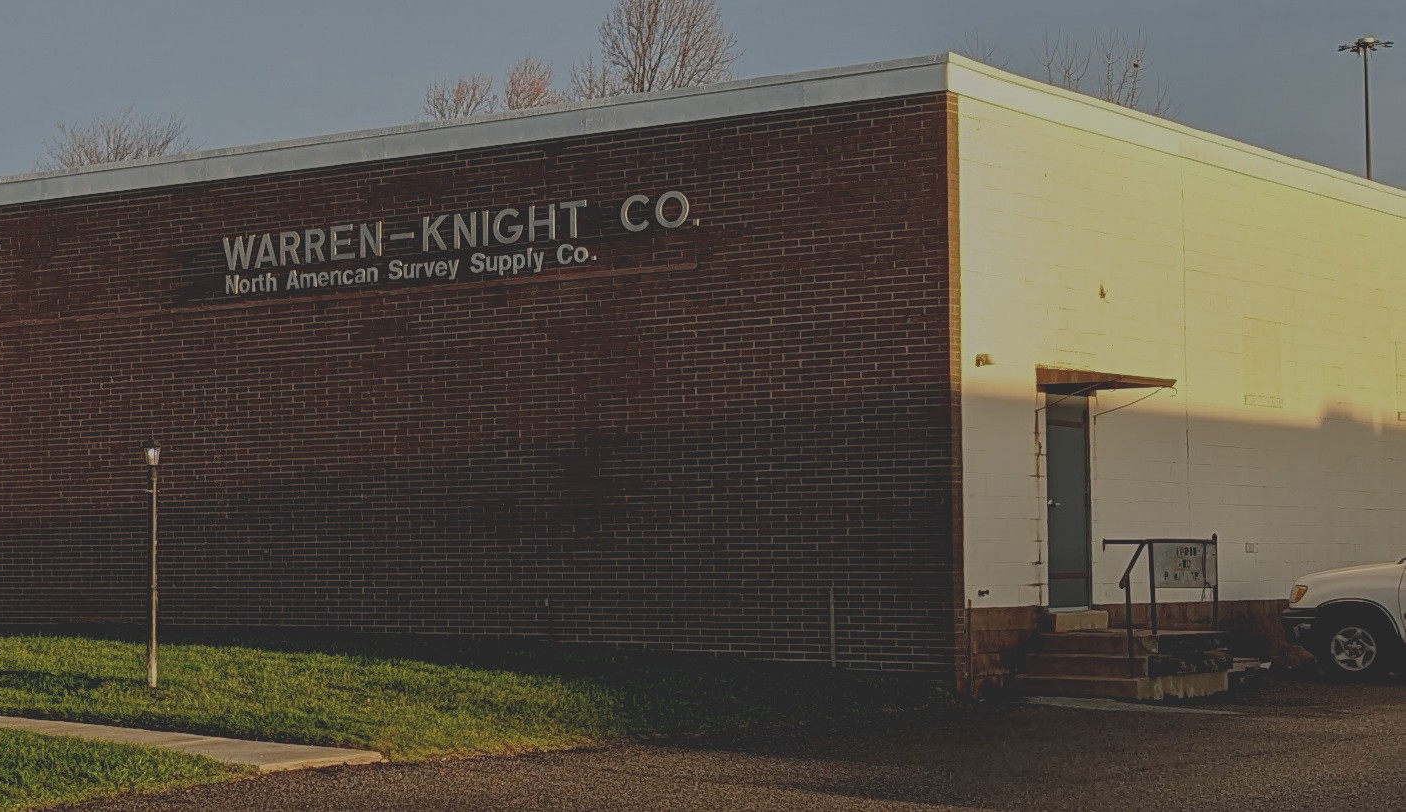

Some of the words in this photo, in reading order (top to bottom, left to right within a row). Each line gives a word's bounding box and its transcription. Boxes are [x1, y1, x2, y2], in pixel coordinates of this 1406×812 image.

[222, 199, 588, 271] WARREN-KNIGHT
[620, 190, 700, 232] CO.
[225, 271, 278, 295] North
[286, 266, 379, 291] American
[388, 258, 460, 281] Survey
[469, 247, 545, 277] Supply
[556, 243, 597, 265] Co.
